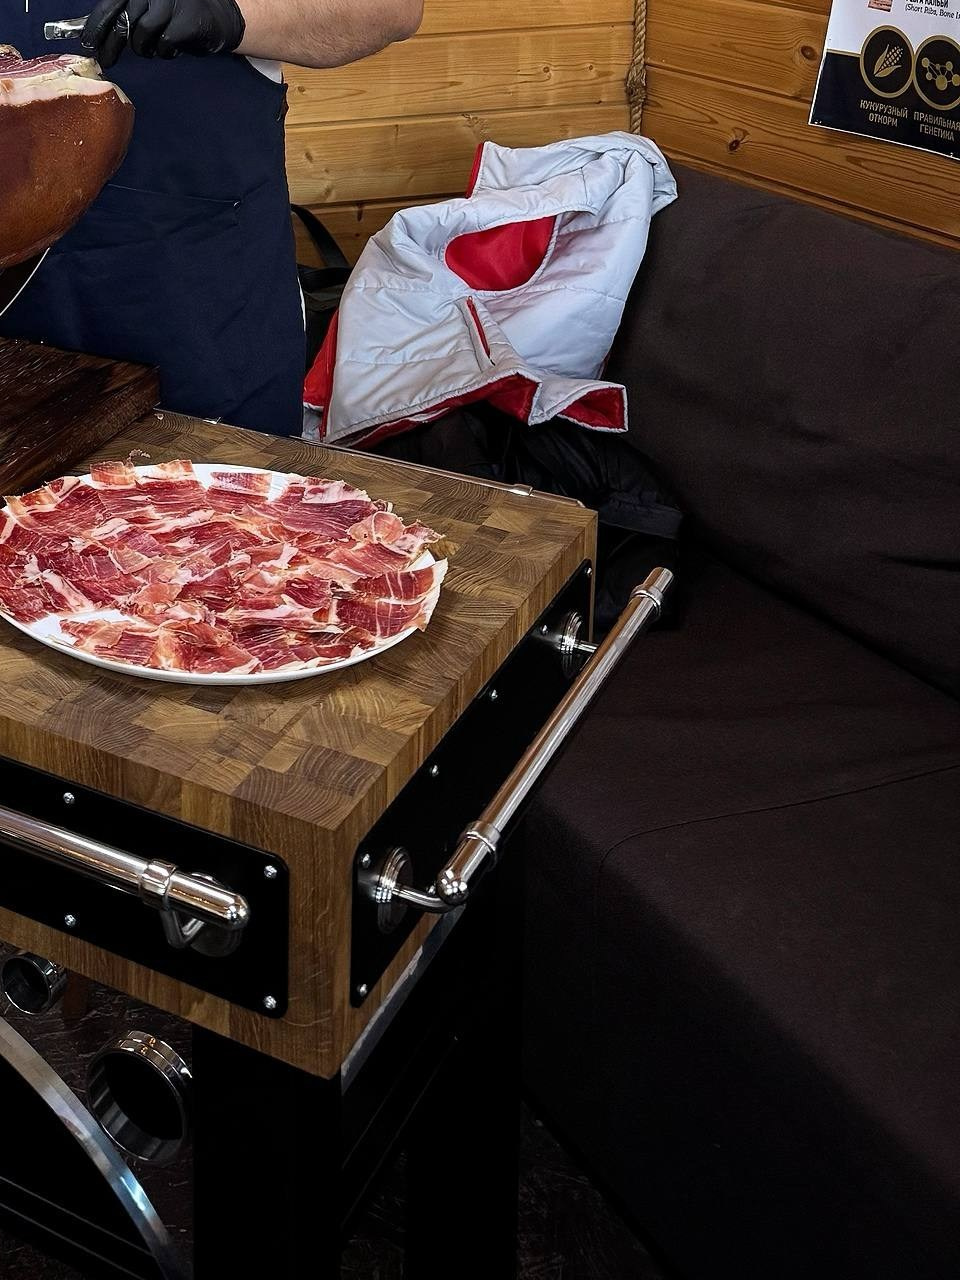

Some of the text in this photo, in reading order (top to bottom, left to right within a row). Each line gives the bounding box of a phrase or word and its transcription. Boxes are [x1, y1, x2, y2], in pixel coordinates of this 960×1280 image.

[905, 3, 922, 13] (Short
[860, 99, 908, 119] КУКУРУЗНЫЙ
[868, 112, 898, 127] ОТКОРМ
[920, 124, 955, 142] ГЕНЕТИКА
